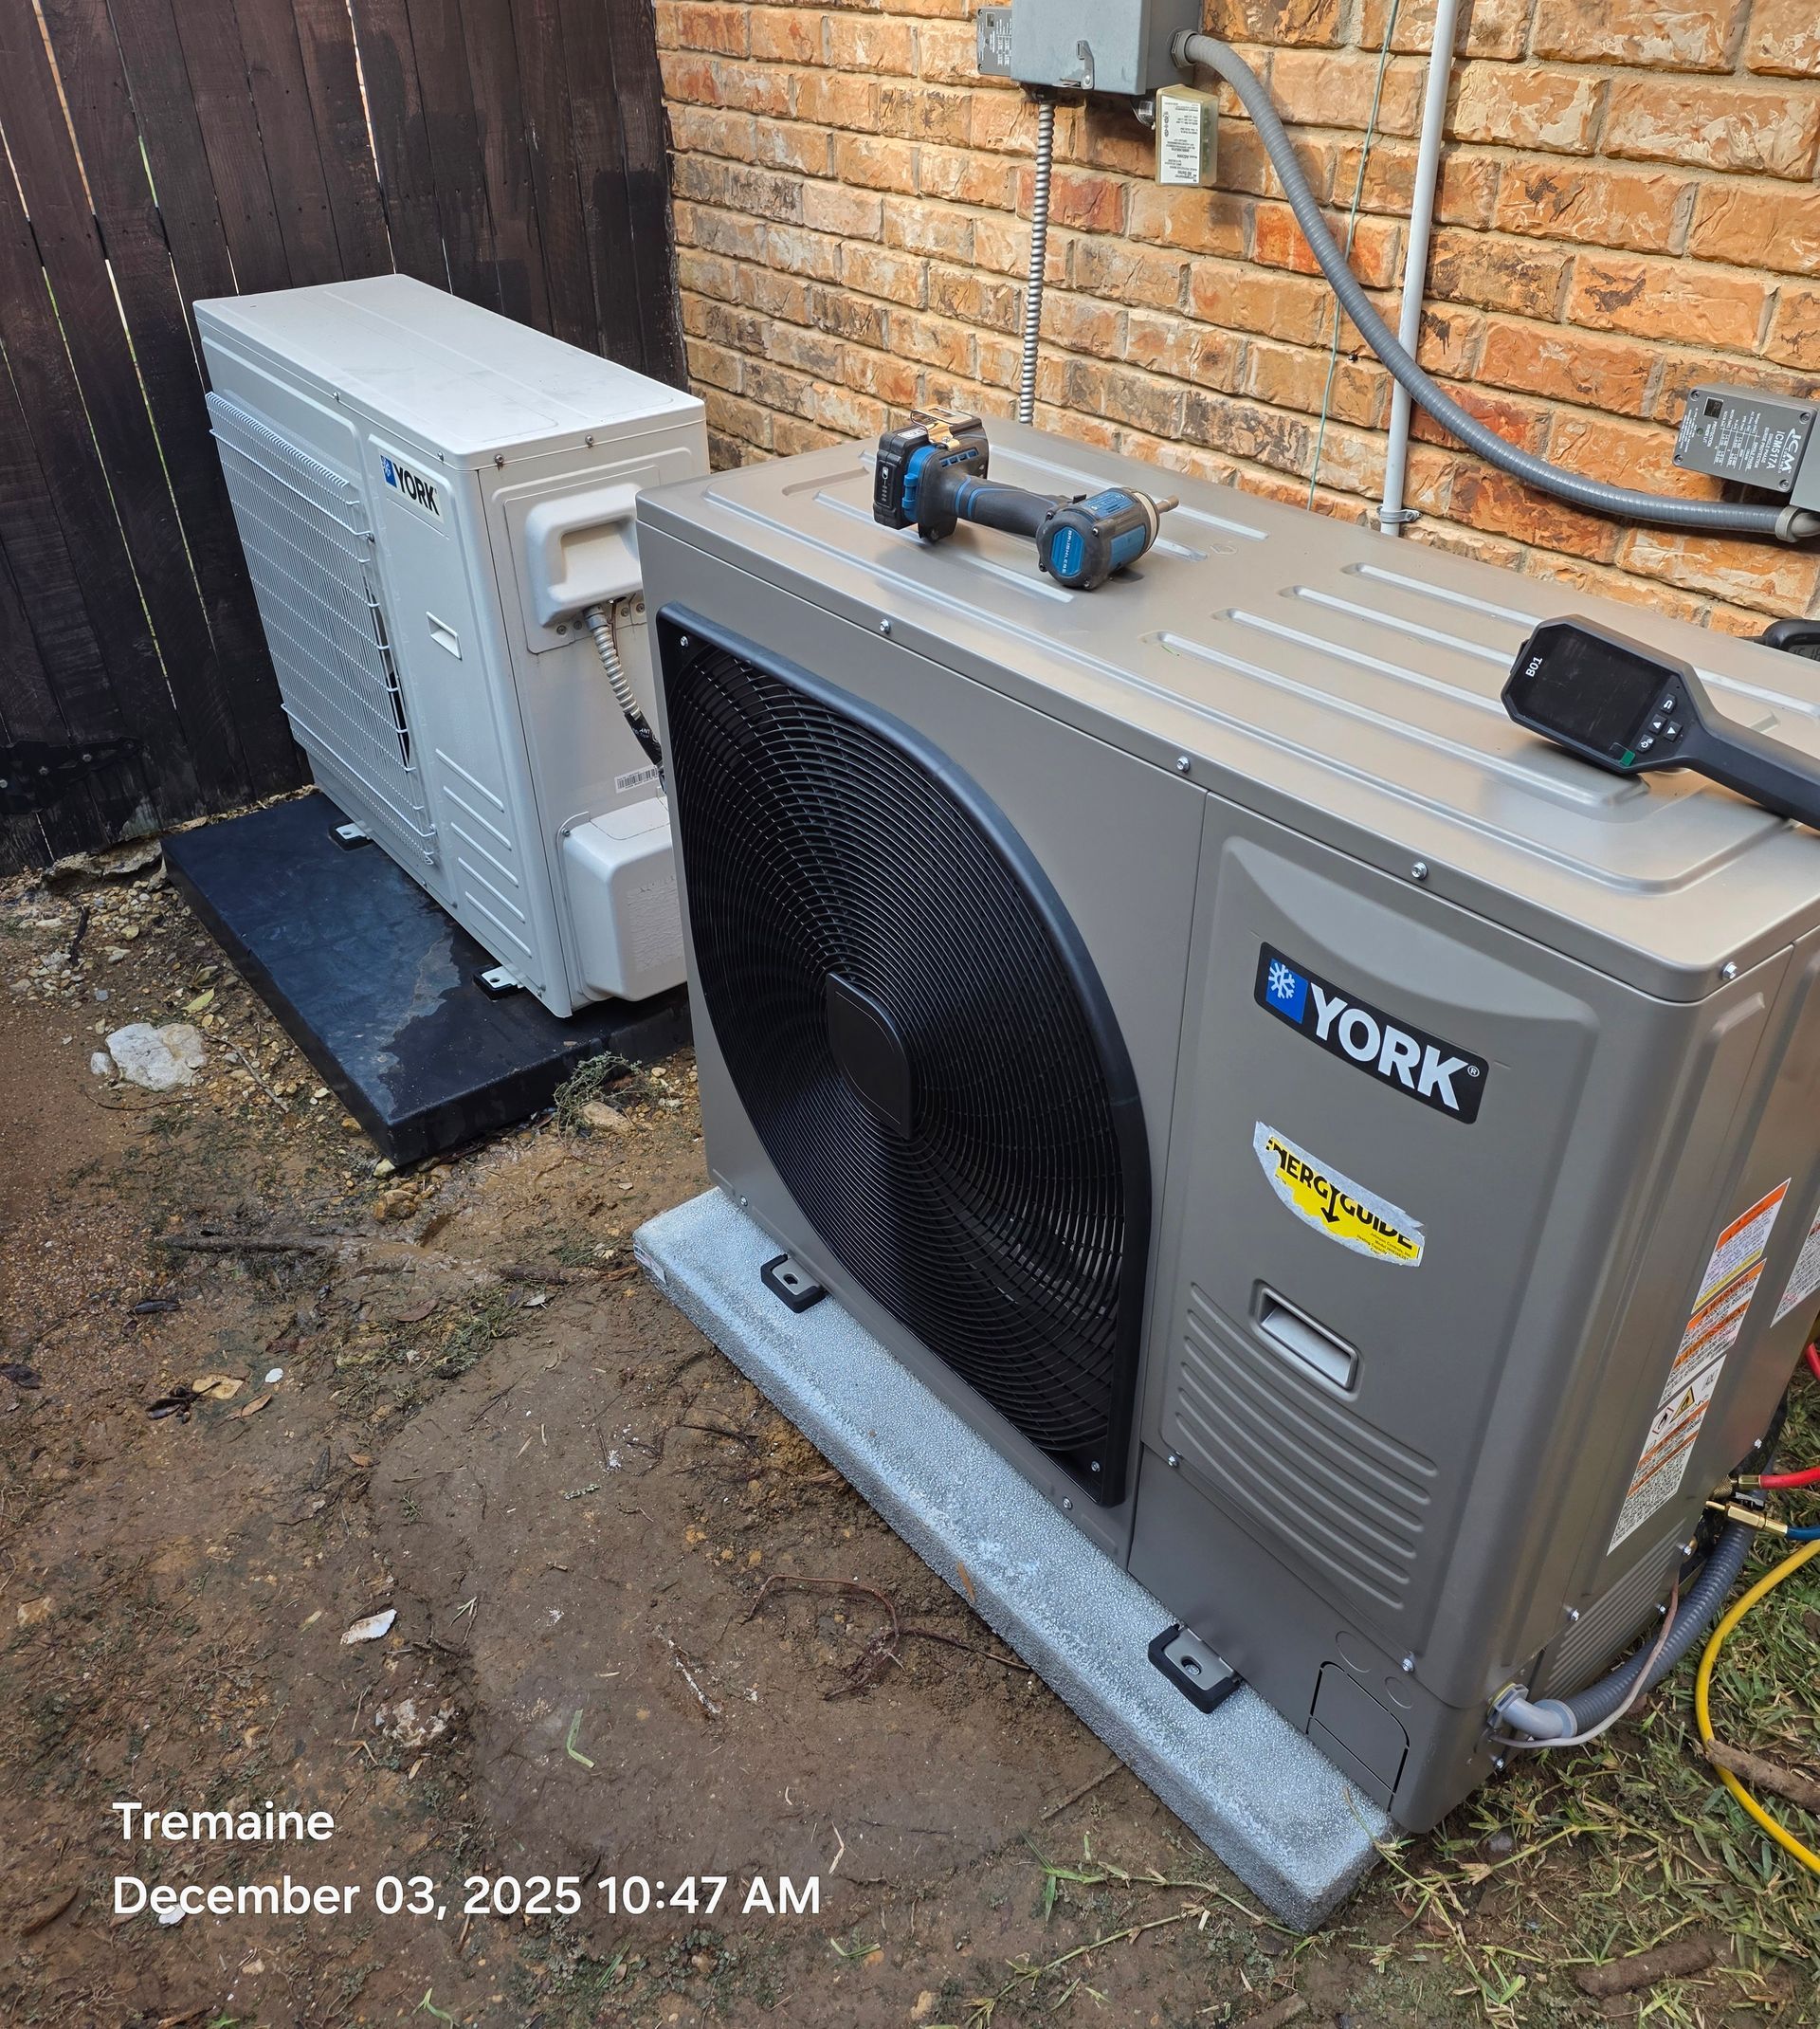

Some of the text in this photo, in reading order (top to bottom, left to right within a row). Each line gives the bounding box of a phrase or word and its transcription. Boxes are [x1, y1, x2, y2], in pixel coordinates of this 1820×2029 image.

[1706, 420, 1718, 448] PROTECTION
[1766, 430, 1786, 469] ICM517A
[1781, 433, 1802, 472] ICM
[1754, 442, 1765, 468] PROTECTION
[392, 462, 440, 517] YORK
[1524, 656, 1543, 677] B01
[1310, 982, 1468, 1111] YORK
